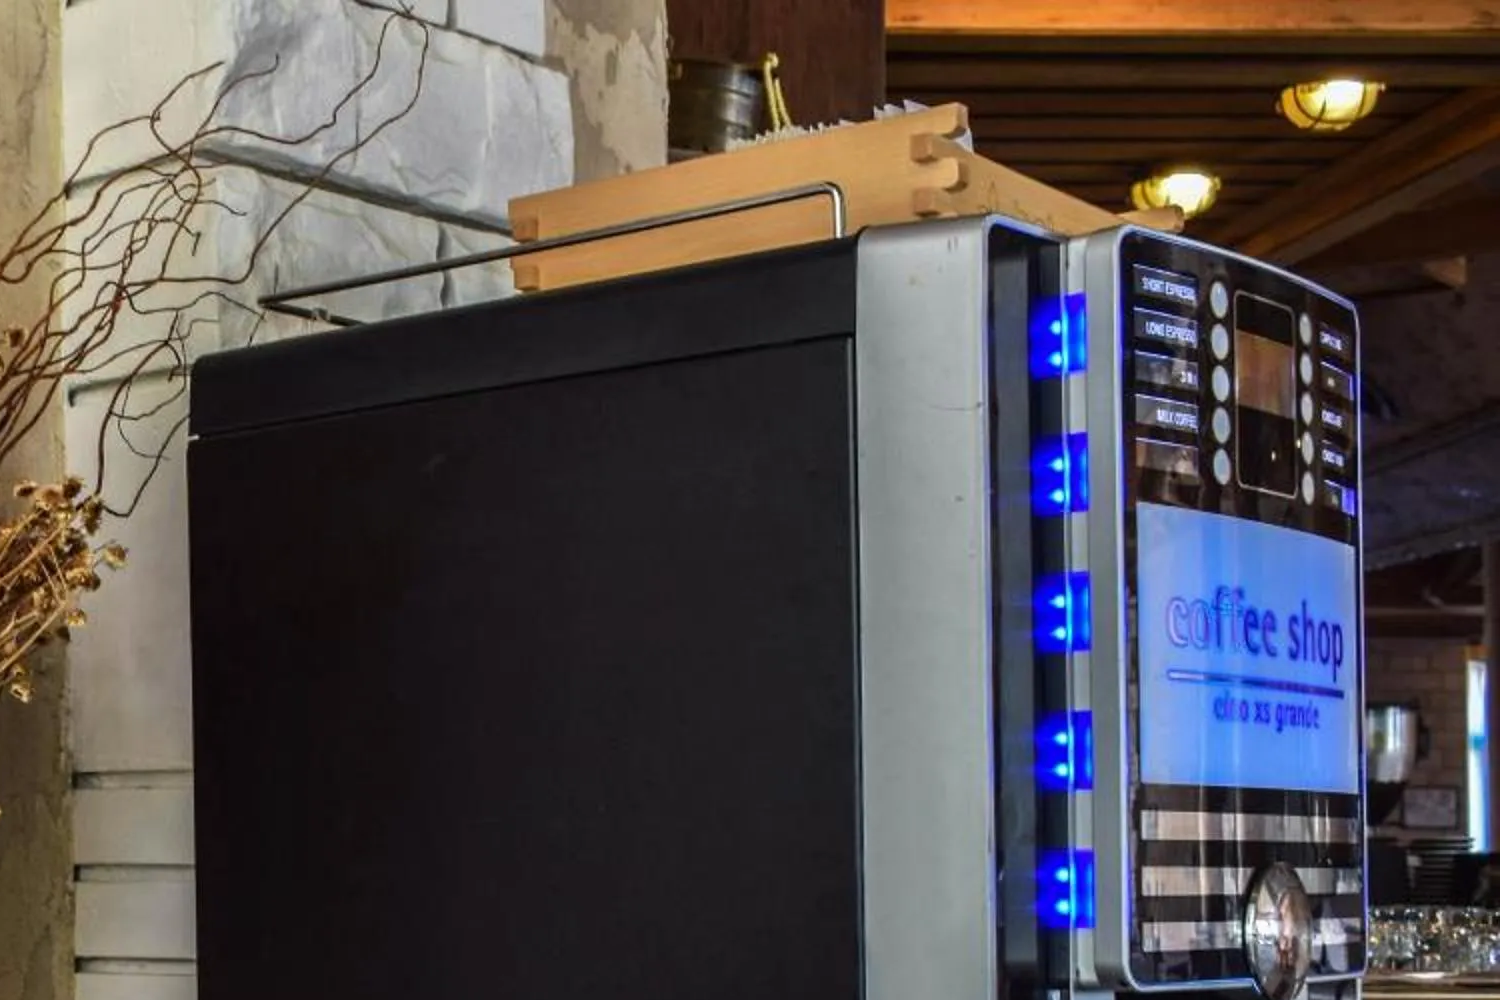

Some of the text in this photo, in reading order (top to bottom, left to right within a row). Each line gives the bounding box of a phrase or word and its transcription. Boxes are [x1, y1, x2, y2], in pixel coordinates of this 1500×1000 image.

[1166, 585, 1343, 682] coffee shop
[1253, 703, 1270, 723] xs
[1276, 701, 1320, 733] grande
